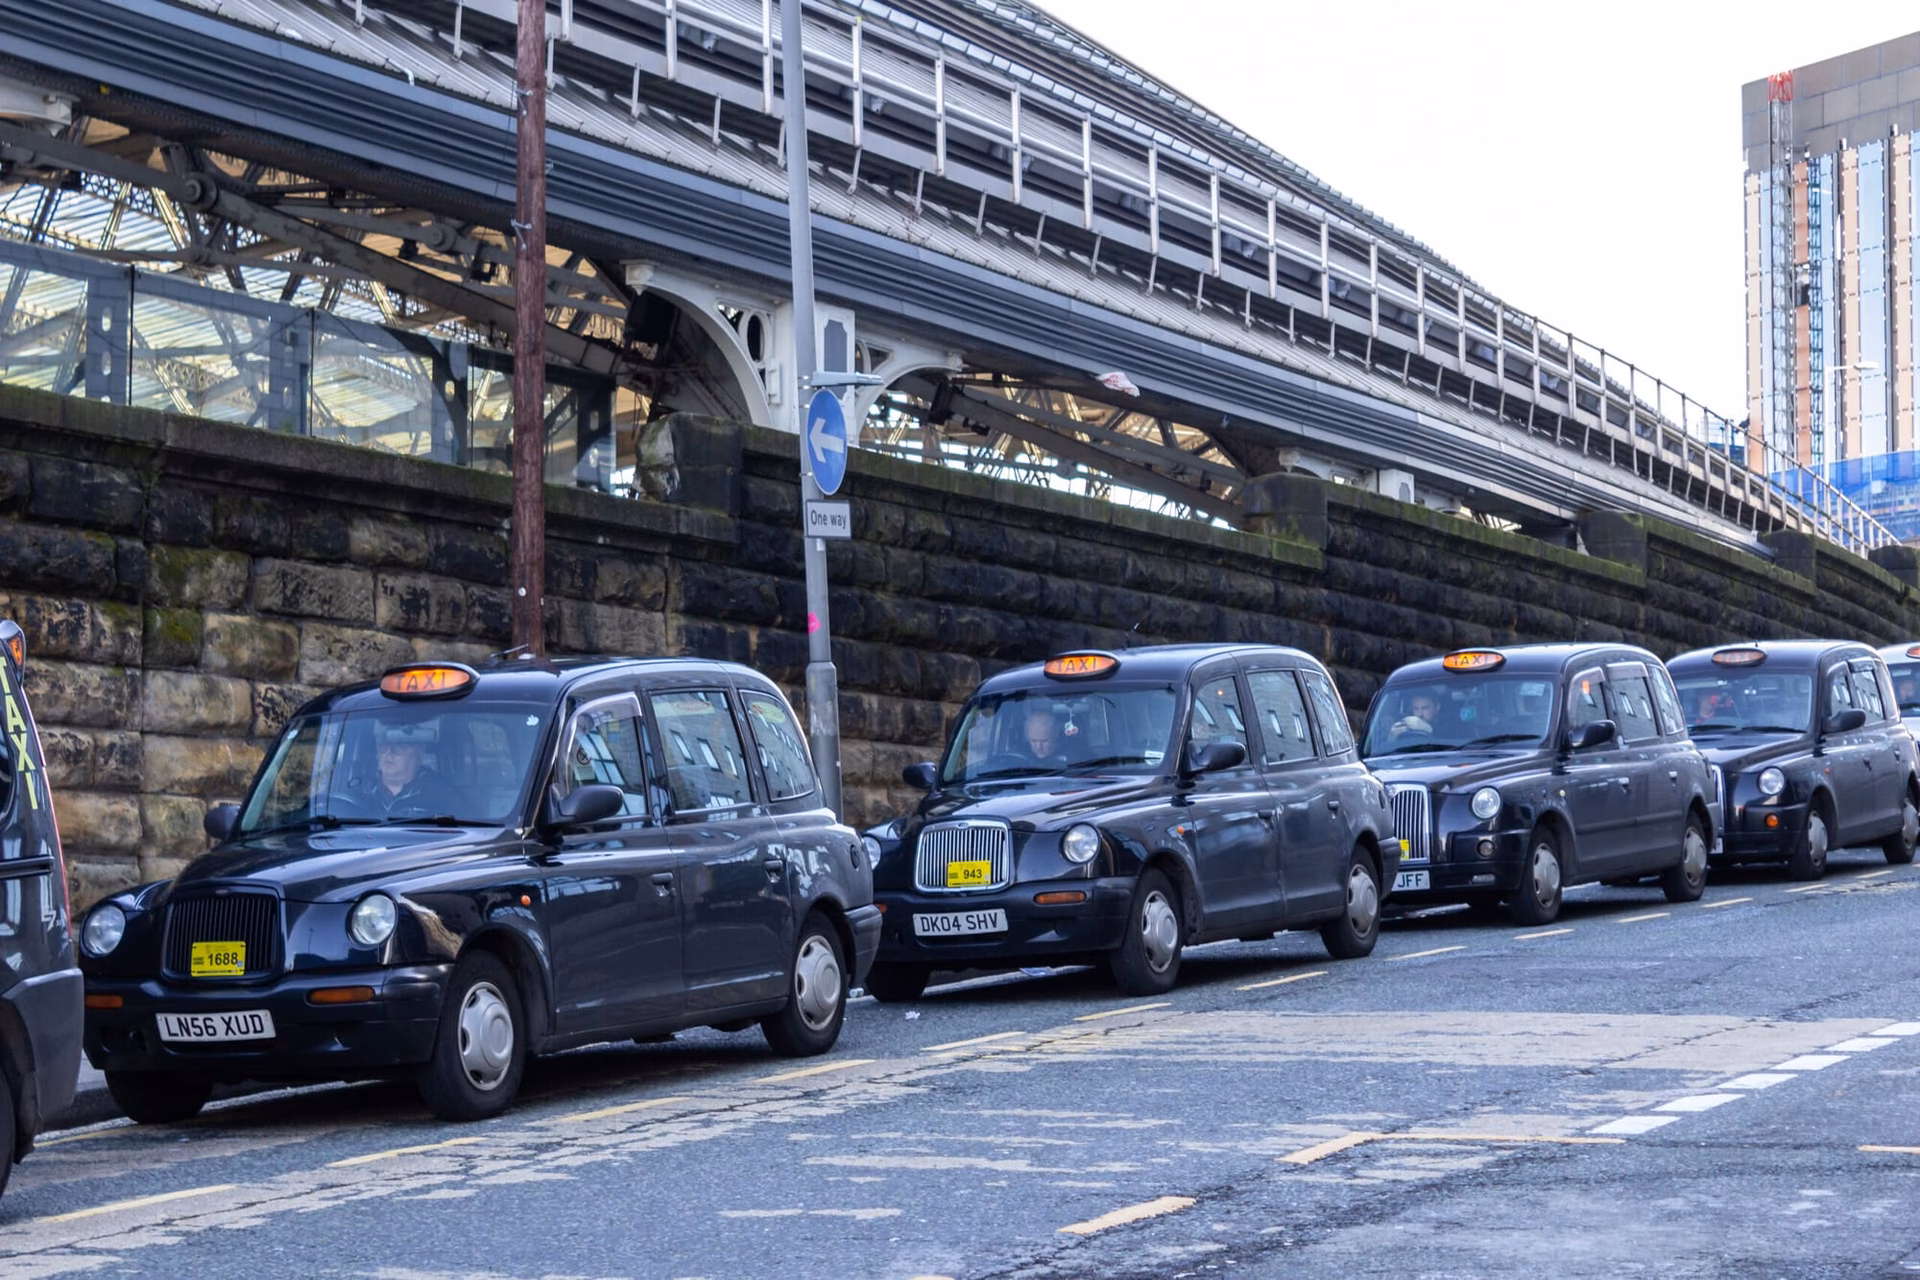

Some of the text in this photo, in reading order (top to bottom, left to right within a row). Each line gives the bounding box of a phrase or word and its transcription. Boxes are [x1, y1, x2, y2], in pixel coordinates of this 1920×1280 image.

[810, 509, 848, 530] One way
[1057, 658, 1097, 672] TAXI
[1453, 654, 1488, 666] TAXI
[395, 671, 446, 691] TAXI
[0, 656, 38, 810] TAXI
[963, 868, 982, 880] 943
[1397, 873, 1424, 888] JFF
[920, 912, 998, 932] DK04 SHV
[207, 952, 239, 966] 1688
[164, 1013, 265, 1037] LN56 XUD
